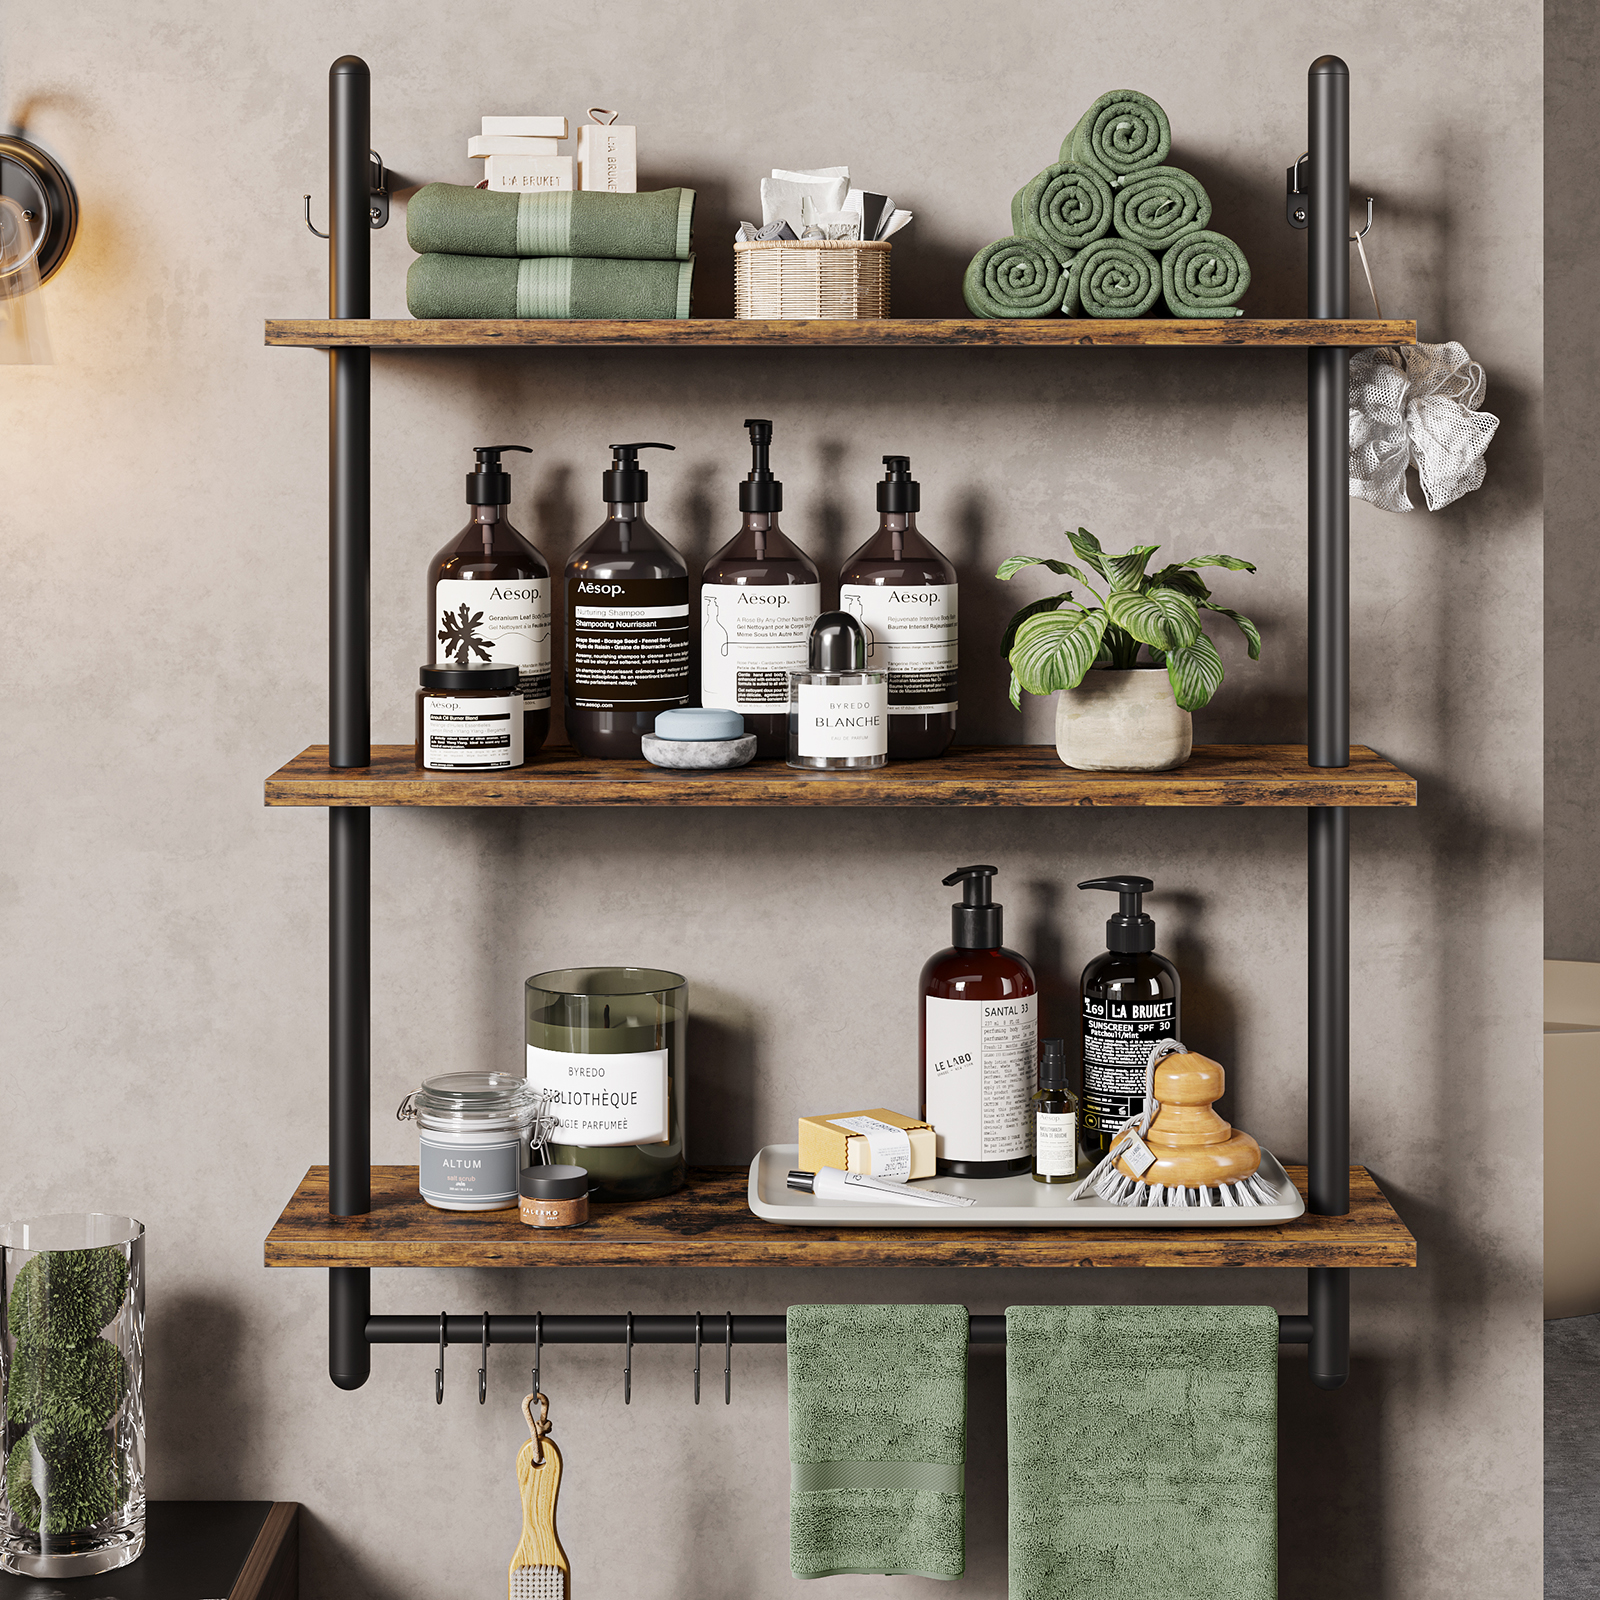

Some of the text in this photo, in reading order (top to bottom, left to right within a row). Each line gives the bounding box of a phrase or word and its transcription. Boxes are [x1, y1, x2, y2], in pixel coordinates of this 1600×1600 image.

[607, 136, 617, 193] L:A BRUKE
[522, 175, 561, 187] BRUKET
[519, 613, 531, 621] Leaf
[576, 608, 646, 617] Nurturing Shampoo
[575, 619, 657, 629] Shampooing Nourrissant
[829, 702, 871, 710] BYREDO
[815, 716, 880, 728] BLANCHE
[984, 1003, 1029, 1017] SANTAL 33
[1085, 1002, 1104, 1016] 169
[1132, 1002, 1173, 1019] BRUKET
[1088, 1020, 1171, 1033] SUNSCREEN SPF 30
[934, 1061, 946, 1072] LE
[946, 1052, 972, 1068] LABO
[568, 1066, 606, 1078] BYREDO
[442, 1158, 482, 1169] ALTUM
